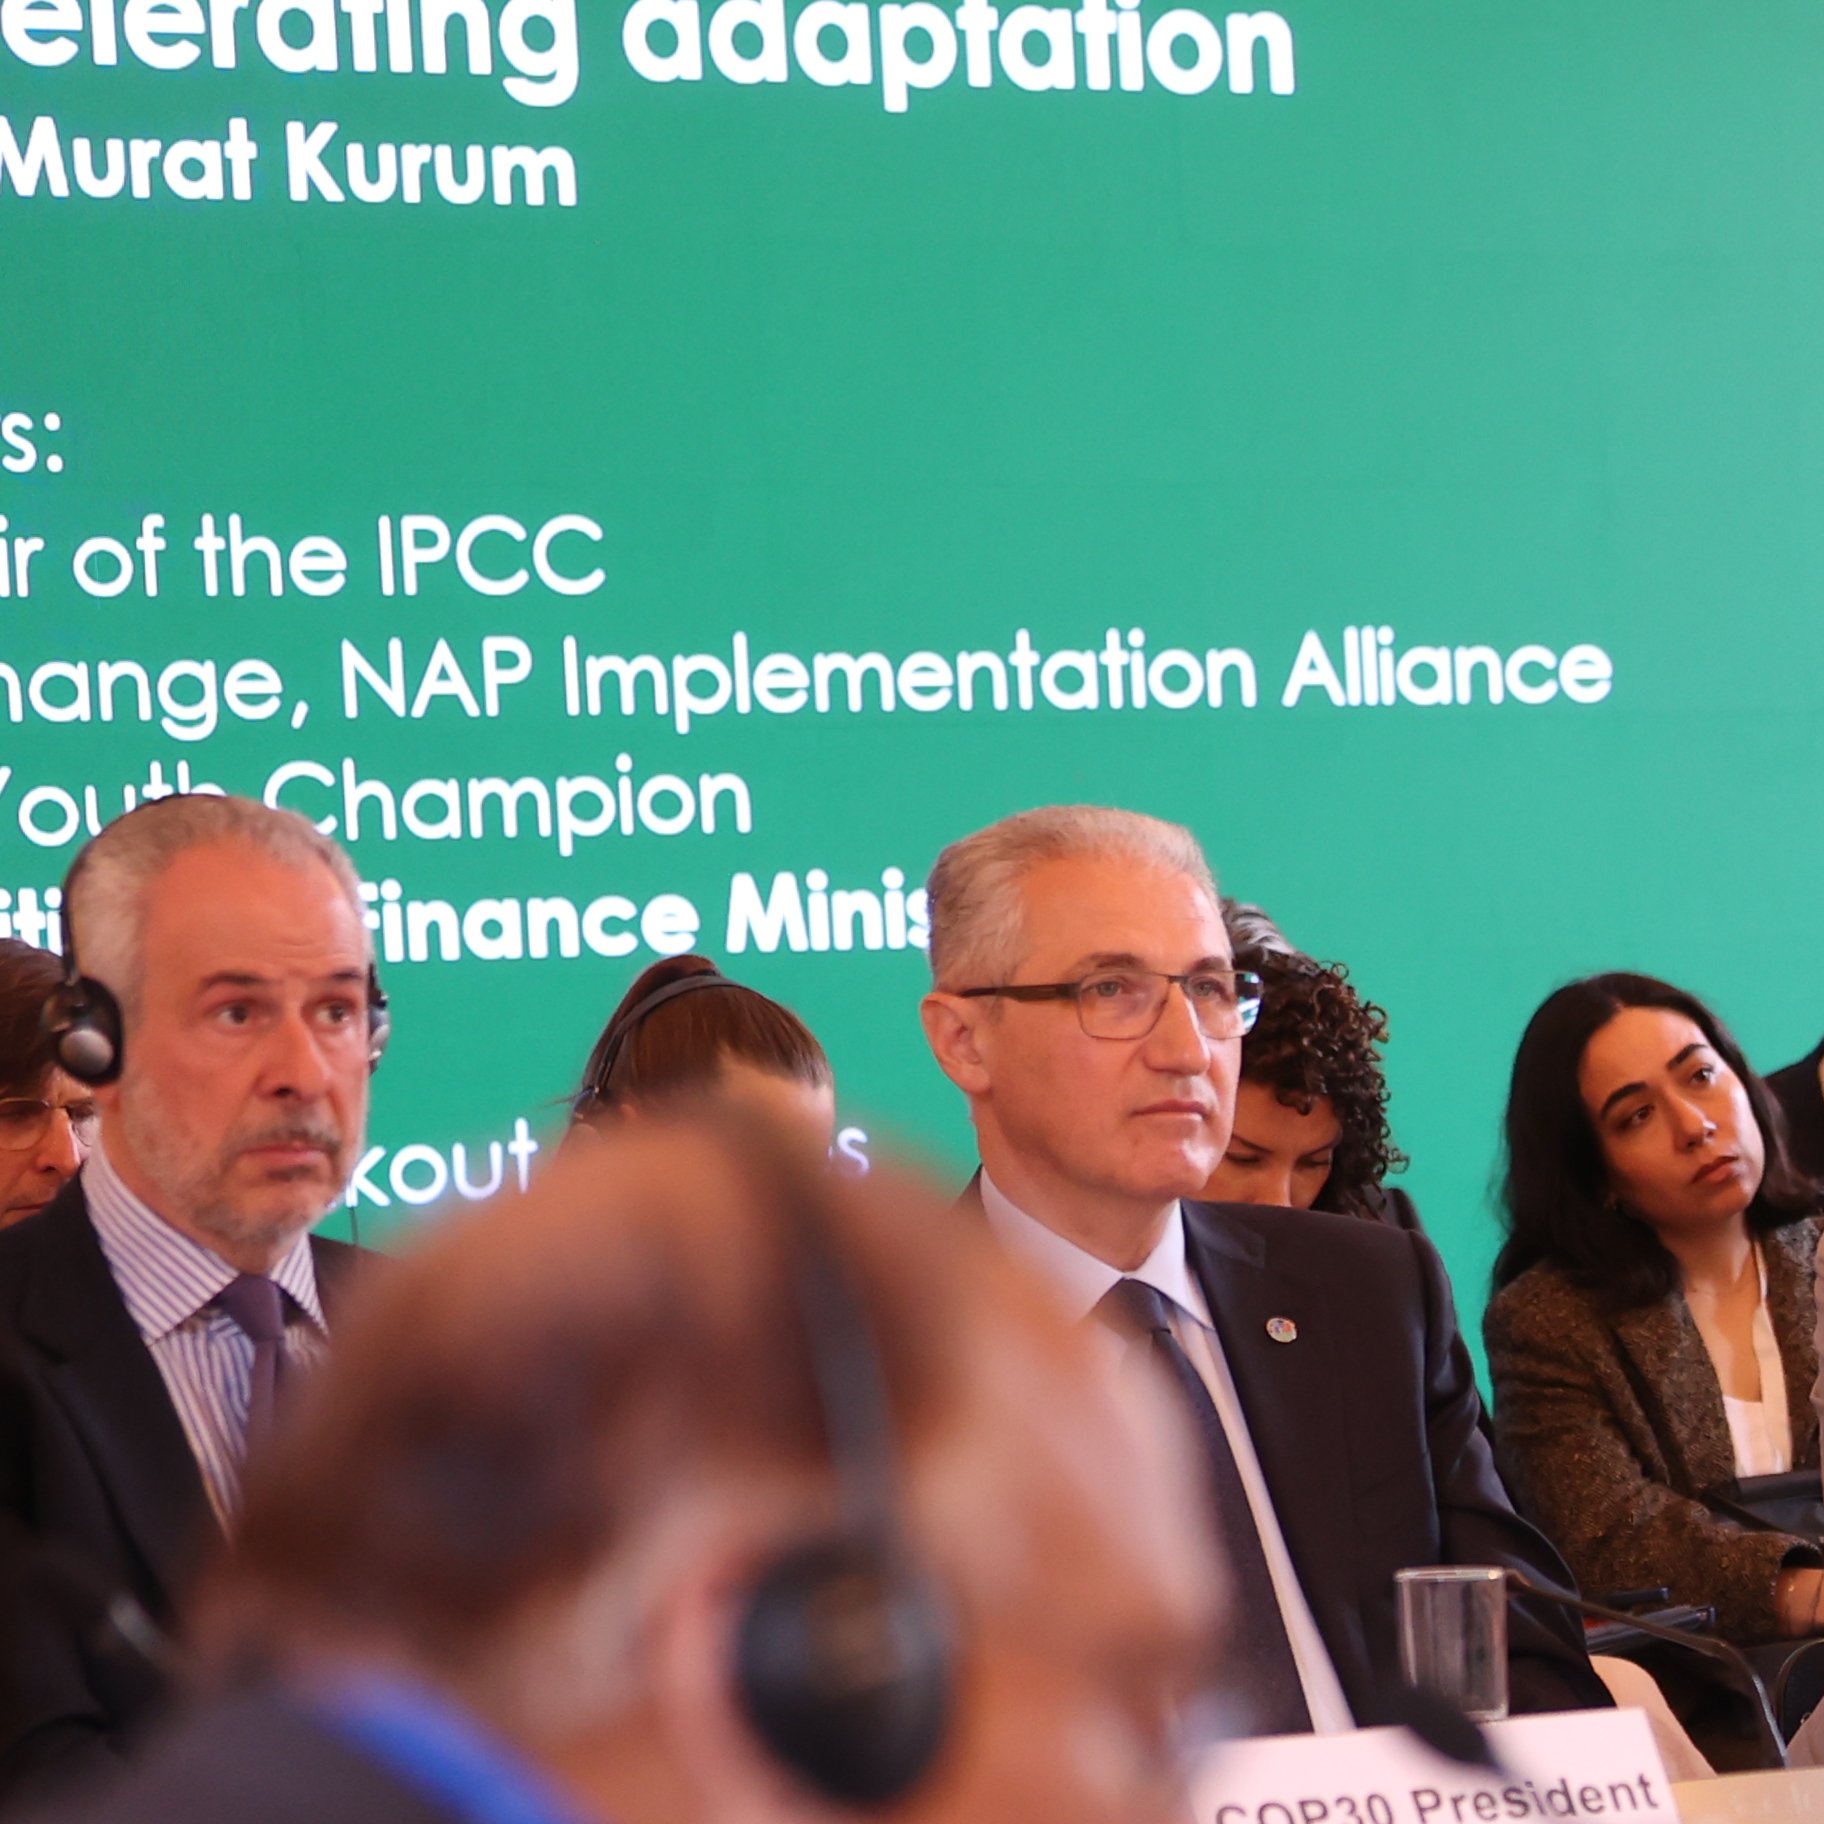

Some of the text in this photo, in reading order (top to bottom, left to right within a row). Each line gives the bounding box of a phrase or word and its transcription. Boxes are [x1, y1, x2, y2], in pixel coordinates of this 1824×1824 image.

[622, 0, 1297, 114] adaptation
[0, 116, 579, 208] Murat Kurum
[72, 513, 168, 599] of
[193, 513, 349, 599] the
[377, 514, 608, 598] IPCC
[341, 635, 535, 720] NAP
[563, 627, 1259, 735] Implementation
[1281, 625, 1615, 712] Alliance
[0, 752, 754, 858] outh Champion
